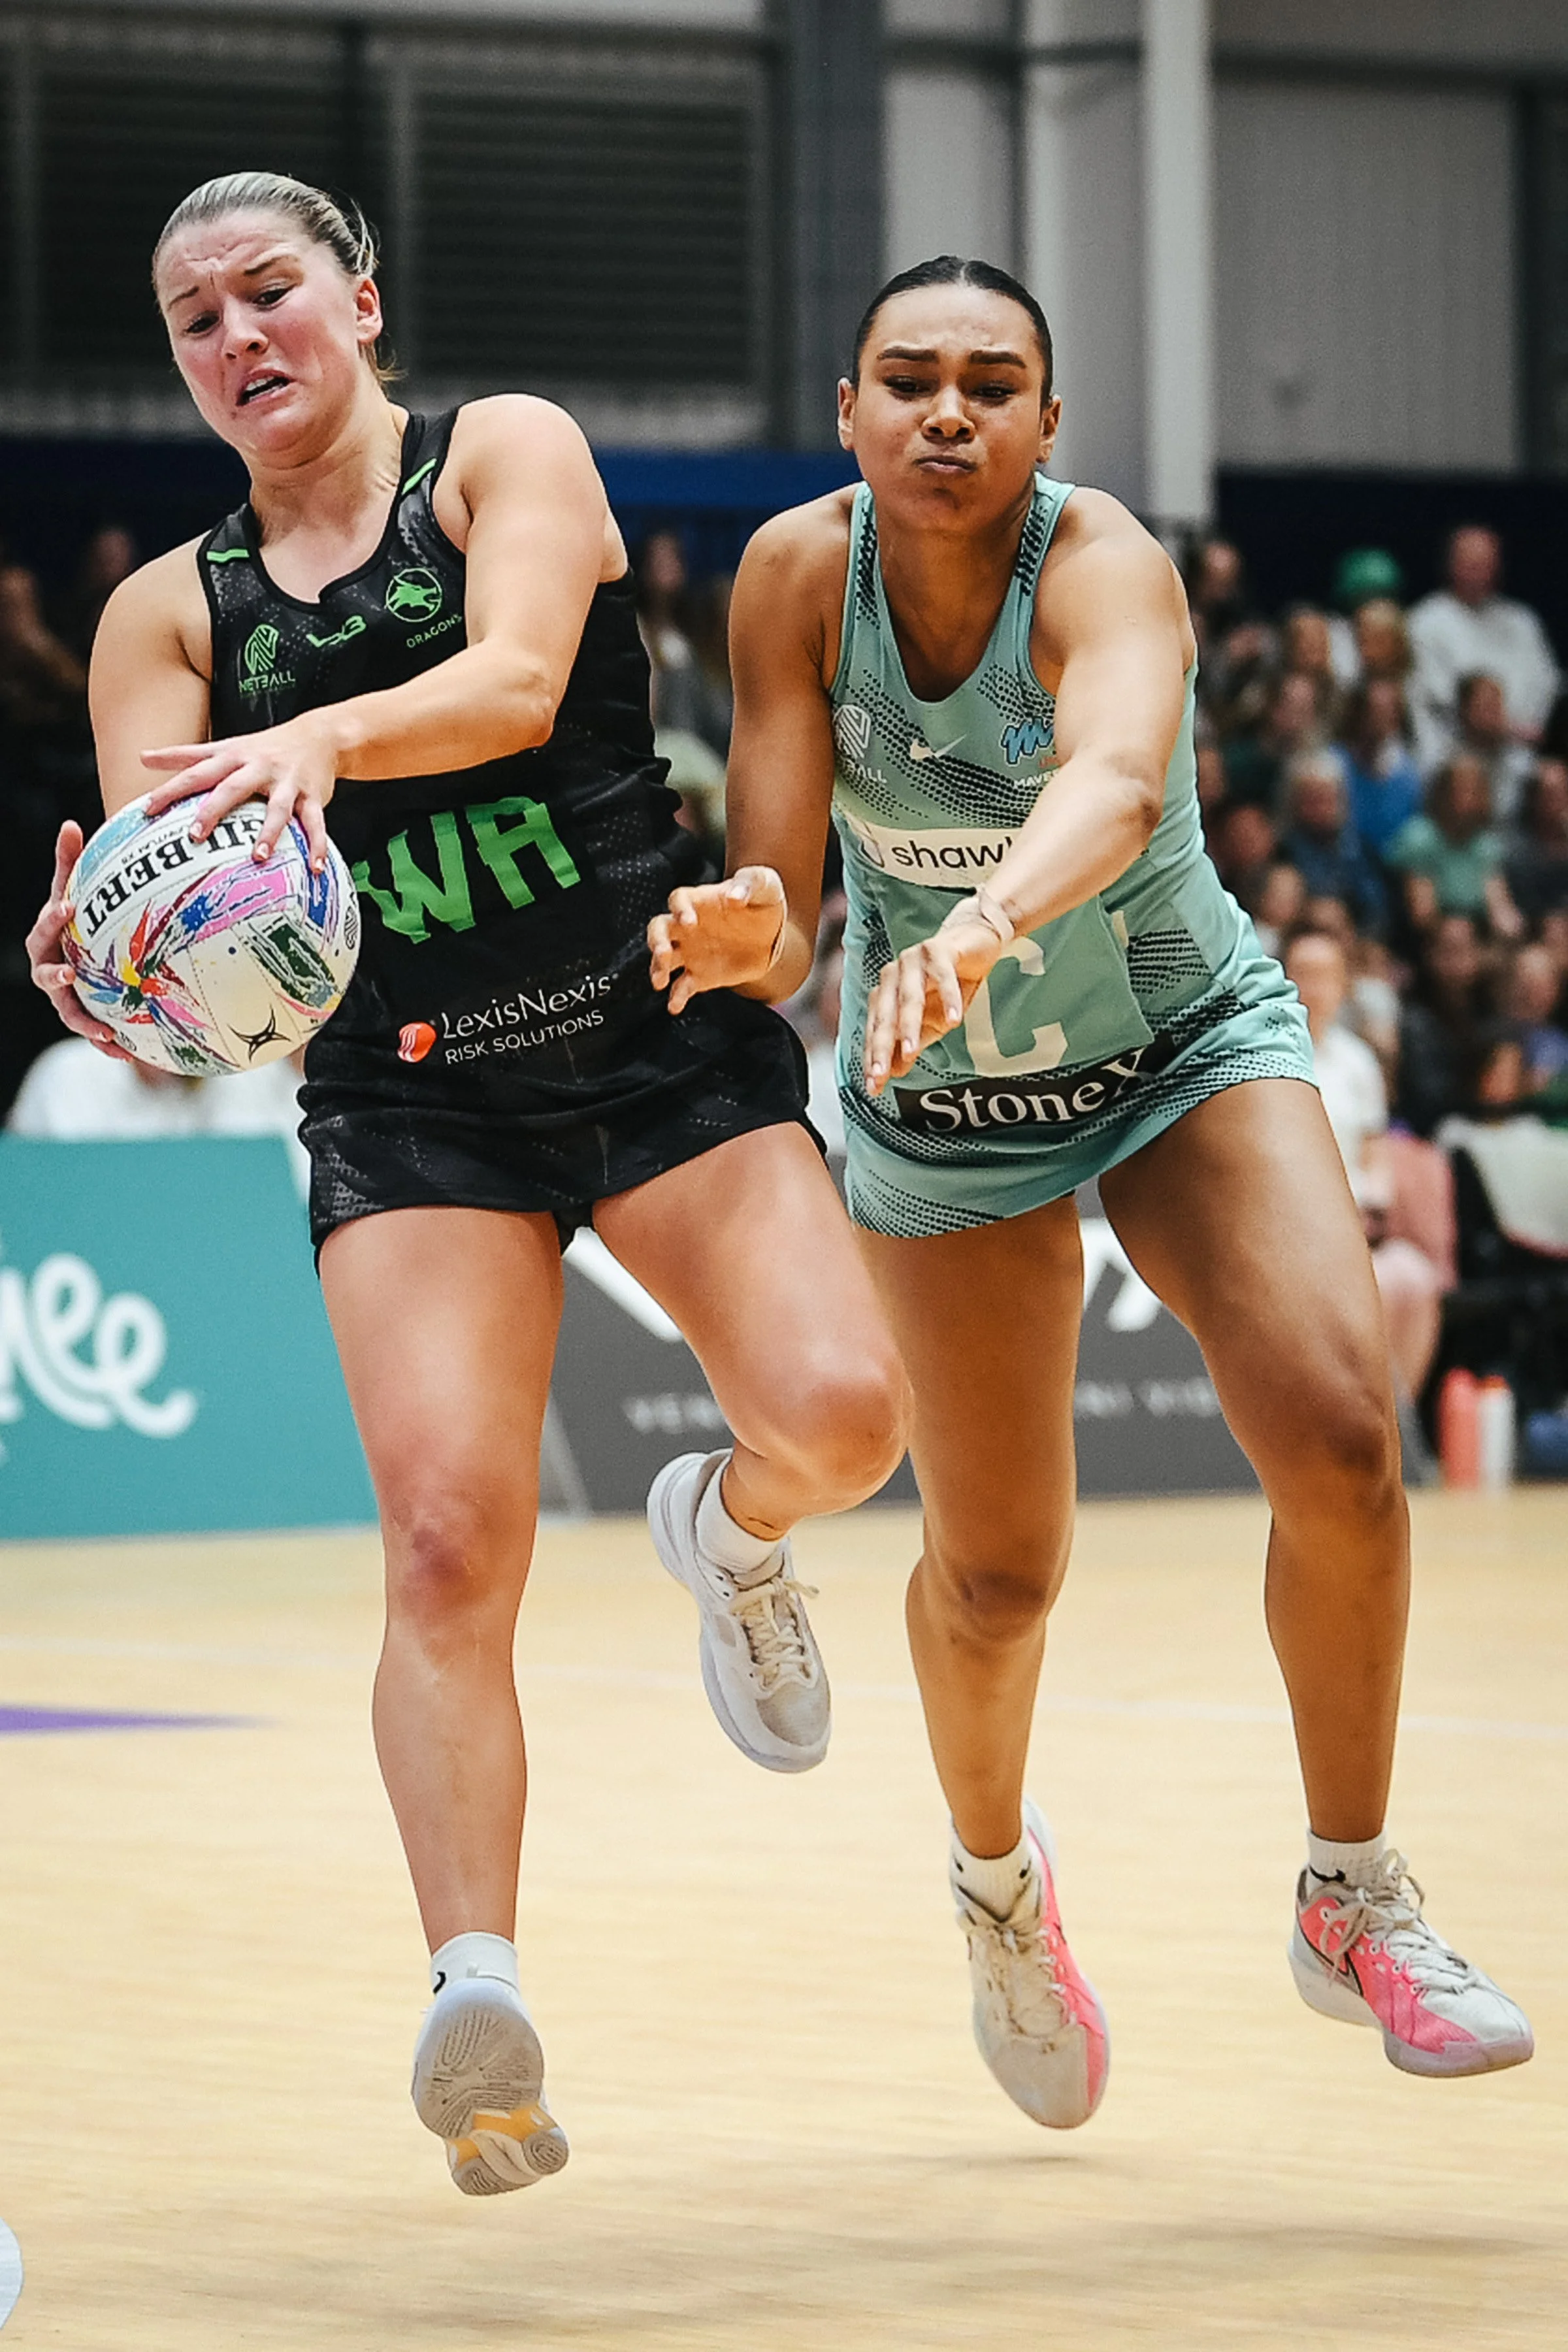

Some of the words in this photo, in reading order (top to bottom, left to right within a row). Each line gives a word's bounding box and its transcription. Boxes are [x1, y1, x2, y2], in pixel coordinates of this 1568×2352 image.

[406, 613, 463, 649] DRAGONS
[351, 796, 581, 945] WA
[891, 836, 1013, 868] shaw
[441, 974, 612, 1040] LexisNexis
[445, 1039, 489, 1065] RISK
[493, 1009, 604, 1053] SOLUTIONS
[965, 936, 1069, 1078] C
[919, 1047, 1154, 1133] StoneX
